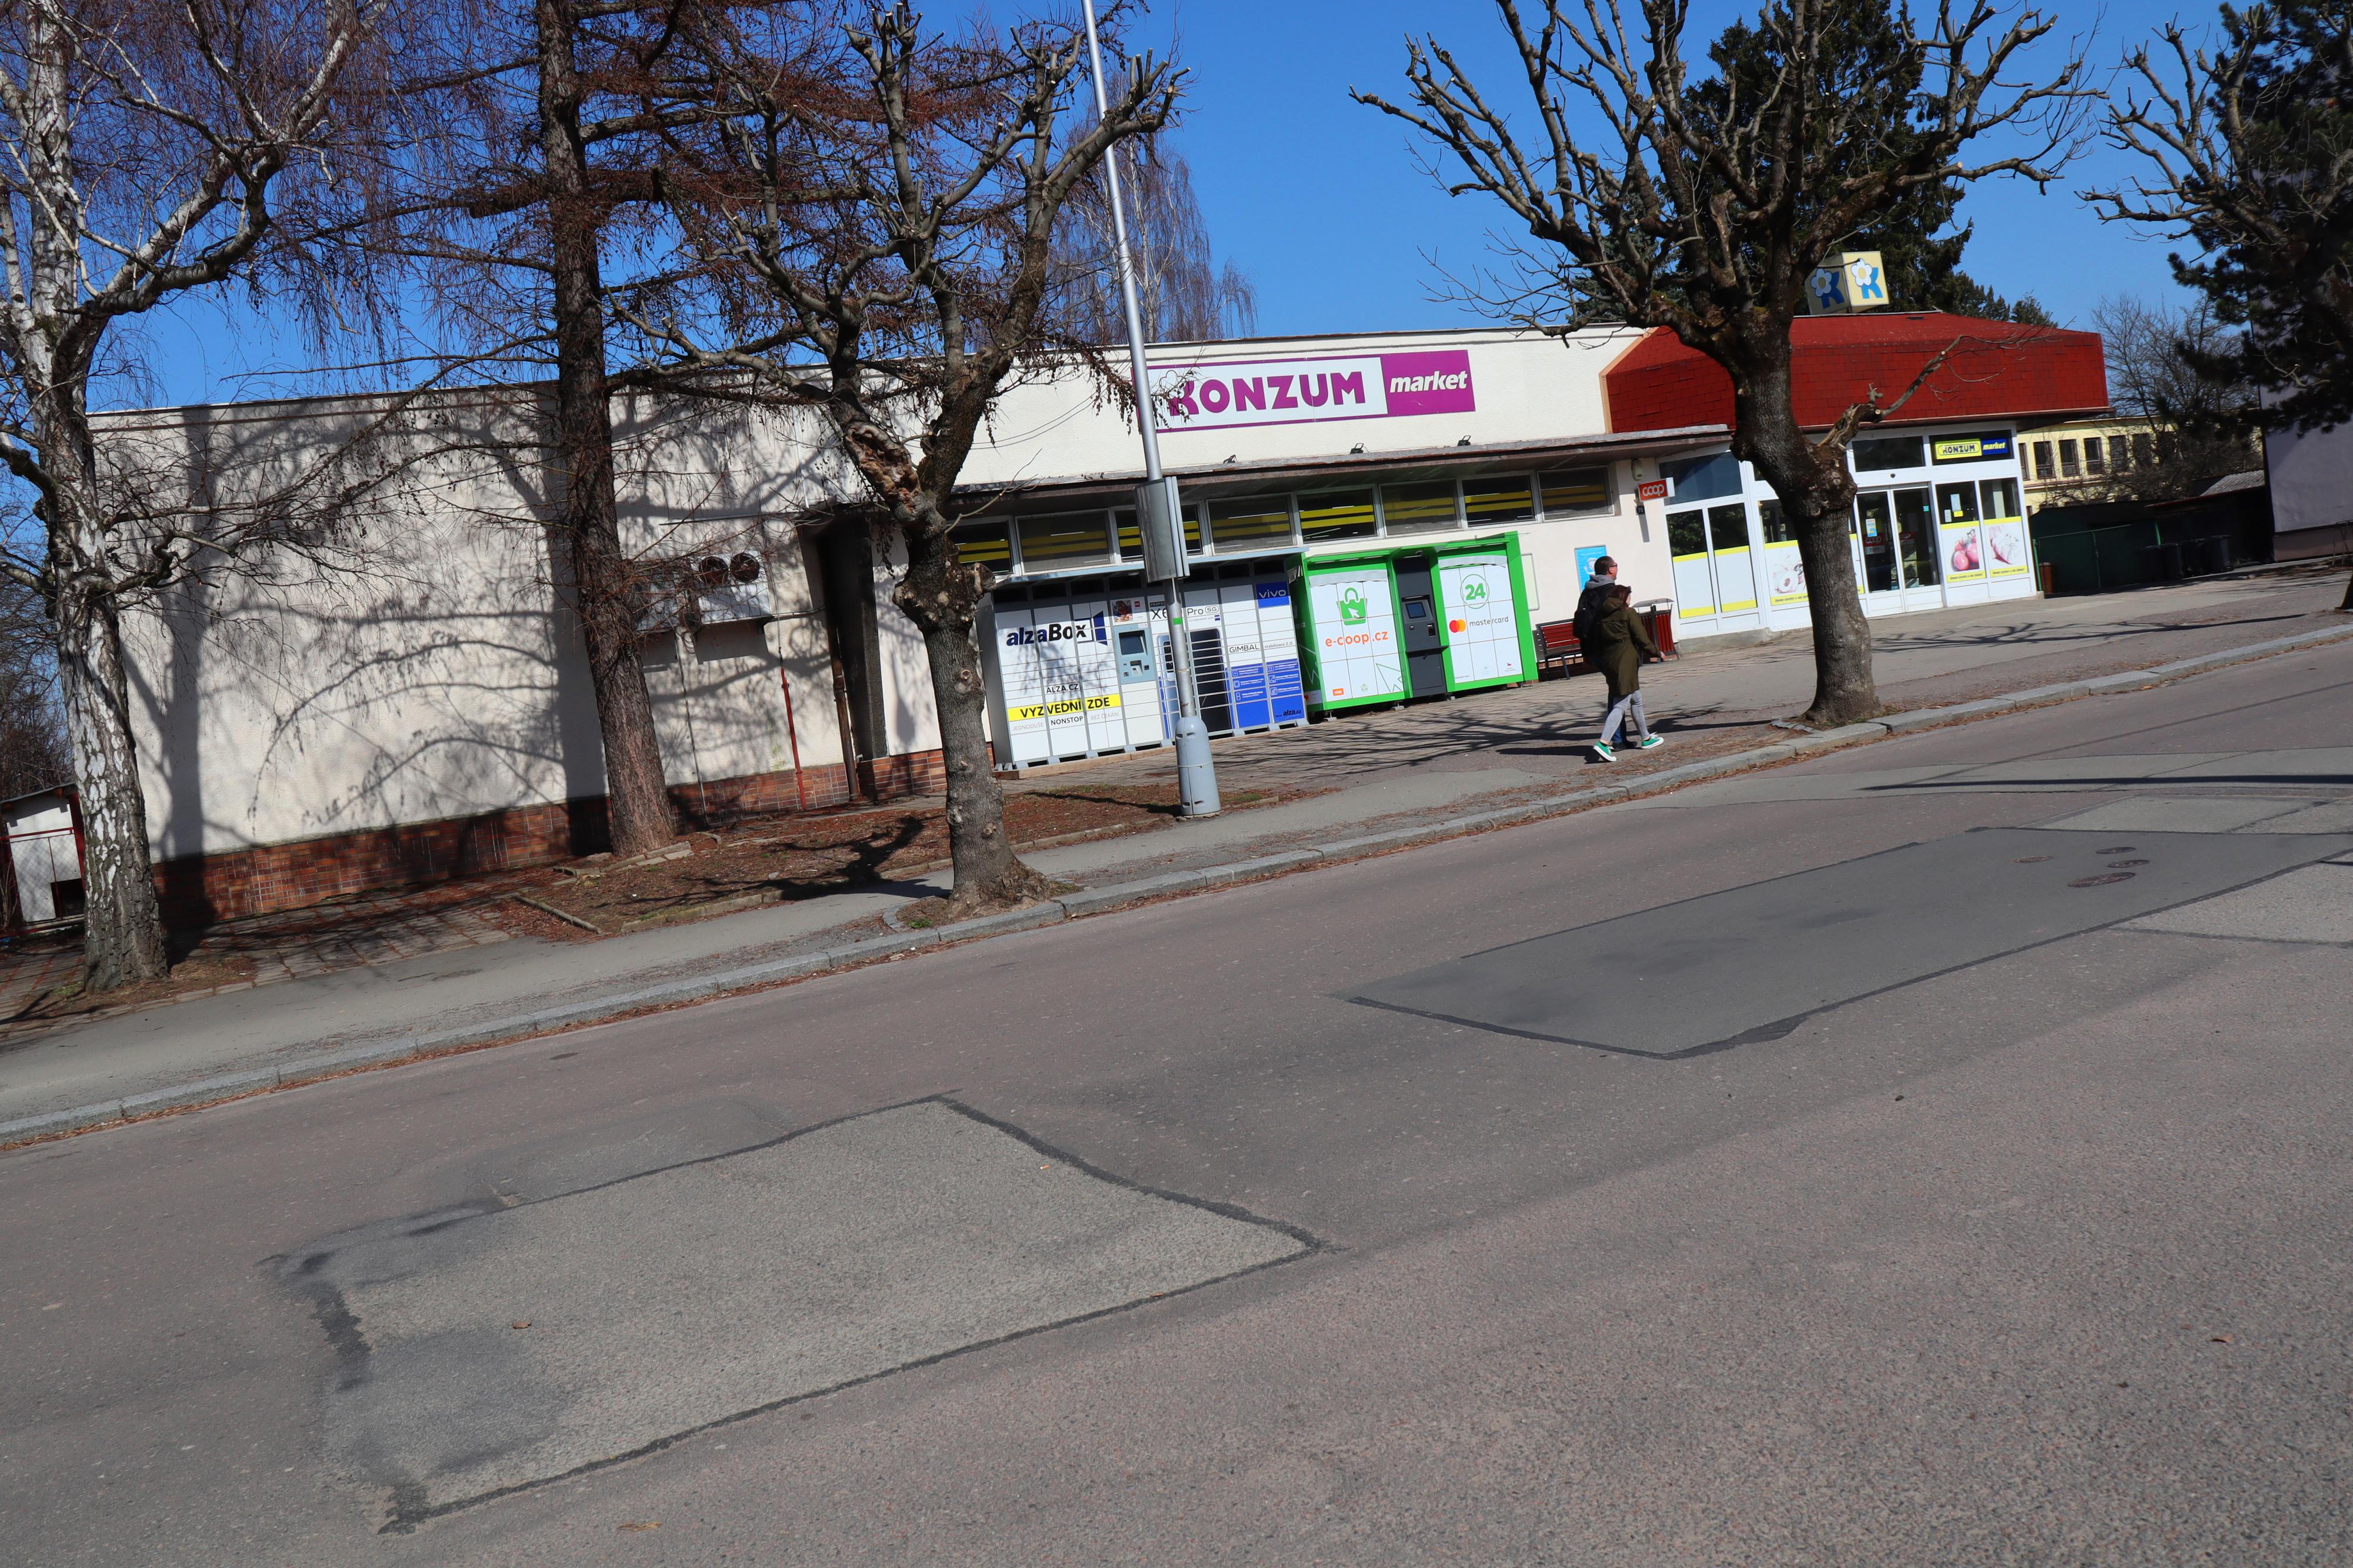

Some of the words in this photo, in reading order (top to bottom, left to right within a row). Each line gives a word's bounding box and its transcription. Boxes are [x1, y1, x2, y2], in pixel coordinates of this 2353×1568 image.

[1169, 371, 1365, 416] KONZUM
[1389, 370, 1468, 393] market
[1942, 445, 1975, 454] KONZUM
[1983, 442, 2006, 451] market
[1642, 483, 1665, 496] coop
[1259, 589, 1287, 598] vivo
[1465, 583, 1486, 600] 24
[1187, 608, 1204, 616] Pro
[1469, 616, 1509, 627] mastercard
[1006, 623, 1086, 646] alzaBox
[1325, 631, 1389, 647] e-coop.cz
[1229, 644, 1259, 653] GIMBAL
[1046, 683, 1079, 693] ALZA.CZ
[1087, 697, 1110, 709] ZDE
[1051, 716, 1084, 725] NONSTOP
